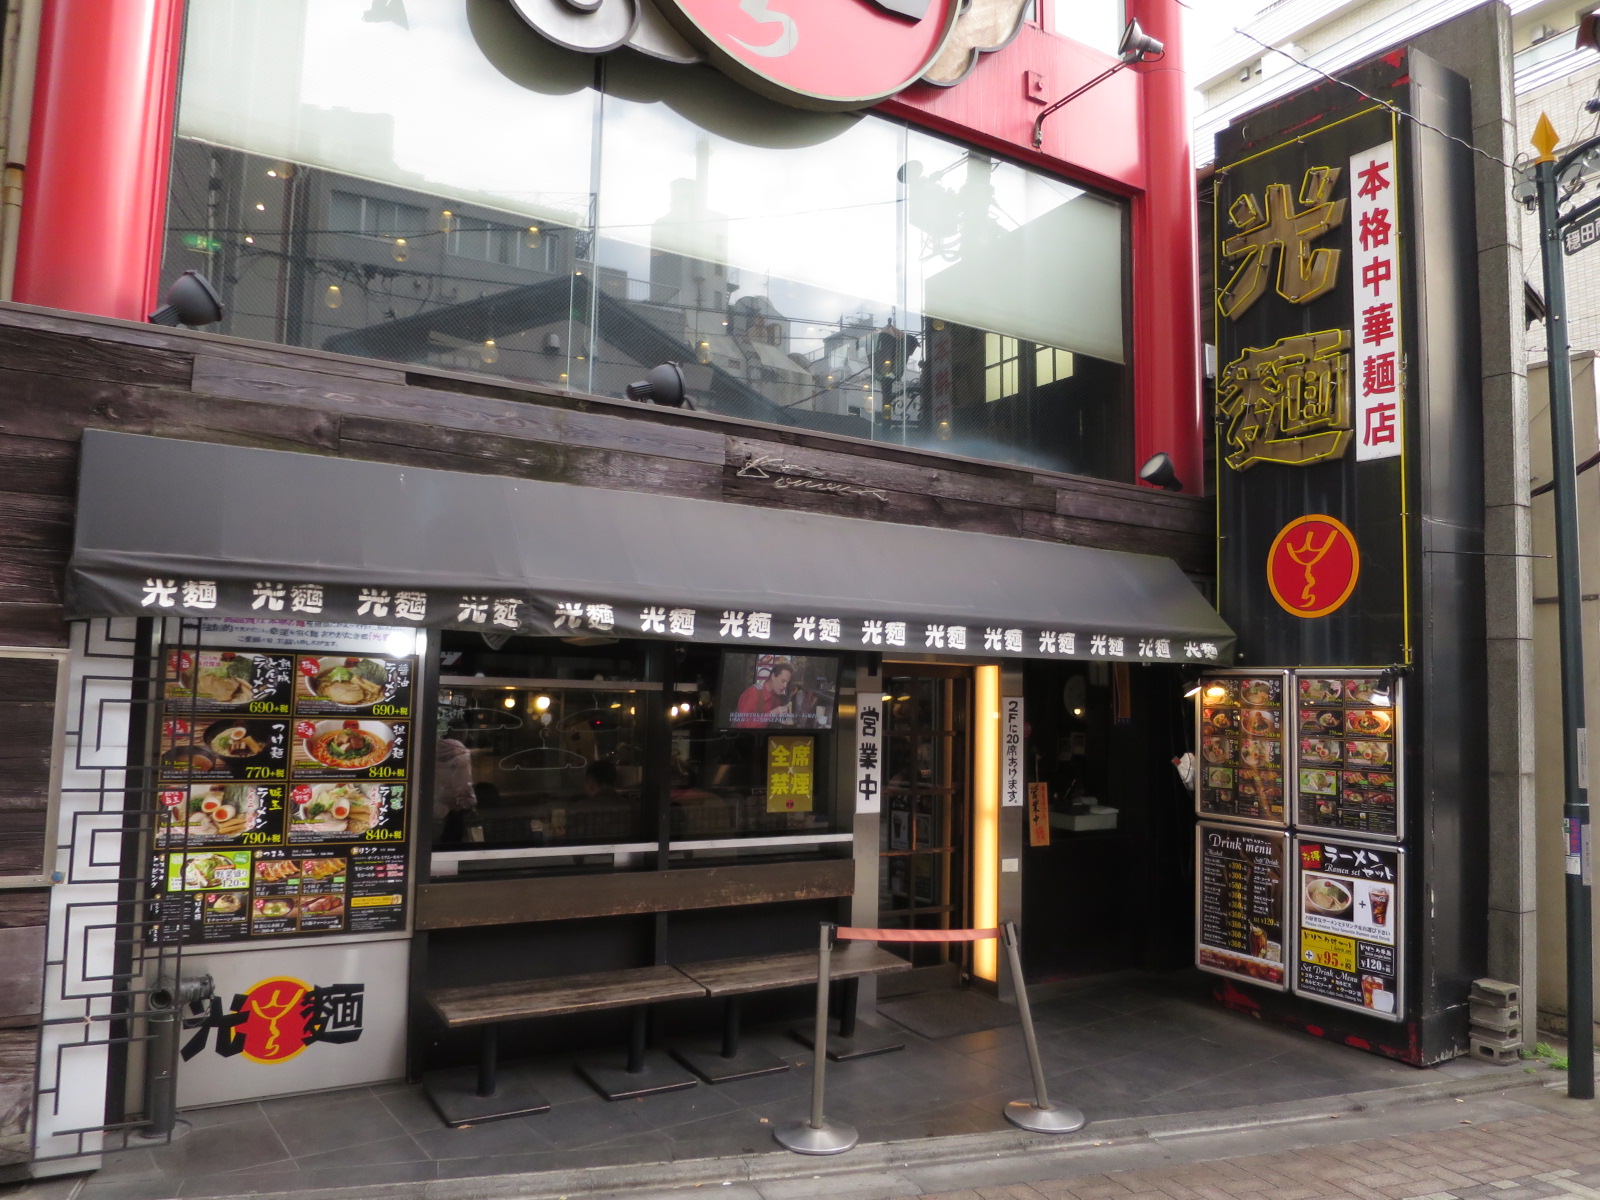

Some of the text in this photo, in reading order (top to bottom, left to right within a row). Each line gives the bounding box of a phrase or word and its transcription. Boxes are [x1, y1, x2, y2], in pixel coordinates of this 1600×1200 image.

[1357, 160, 1397, 446] 本格中華麺店
[252, 656, 268, 699] ラーメン
[384, 662, 397, 702] ラーメン
[771, 745, 811, 767] 全席
[858, 705, 880, 801] 営業中
[770, 773, 810, 796] 禁煙
[255, 787, 269, 829] ラーメン
[378, 786, 390, 826] ラーメン
[1208, 833, 1272, 855] Drink menu
[1323, 845, 1384, 869] ラーメン
[1324, 862, 1361, 876] Ramen set
[1361, 866, 1394, 880] セット
[1300, 962, 1358, 983] Set Drink Menu
